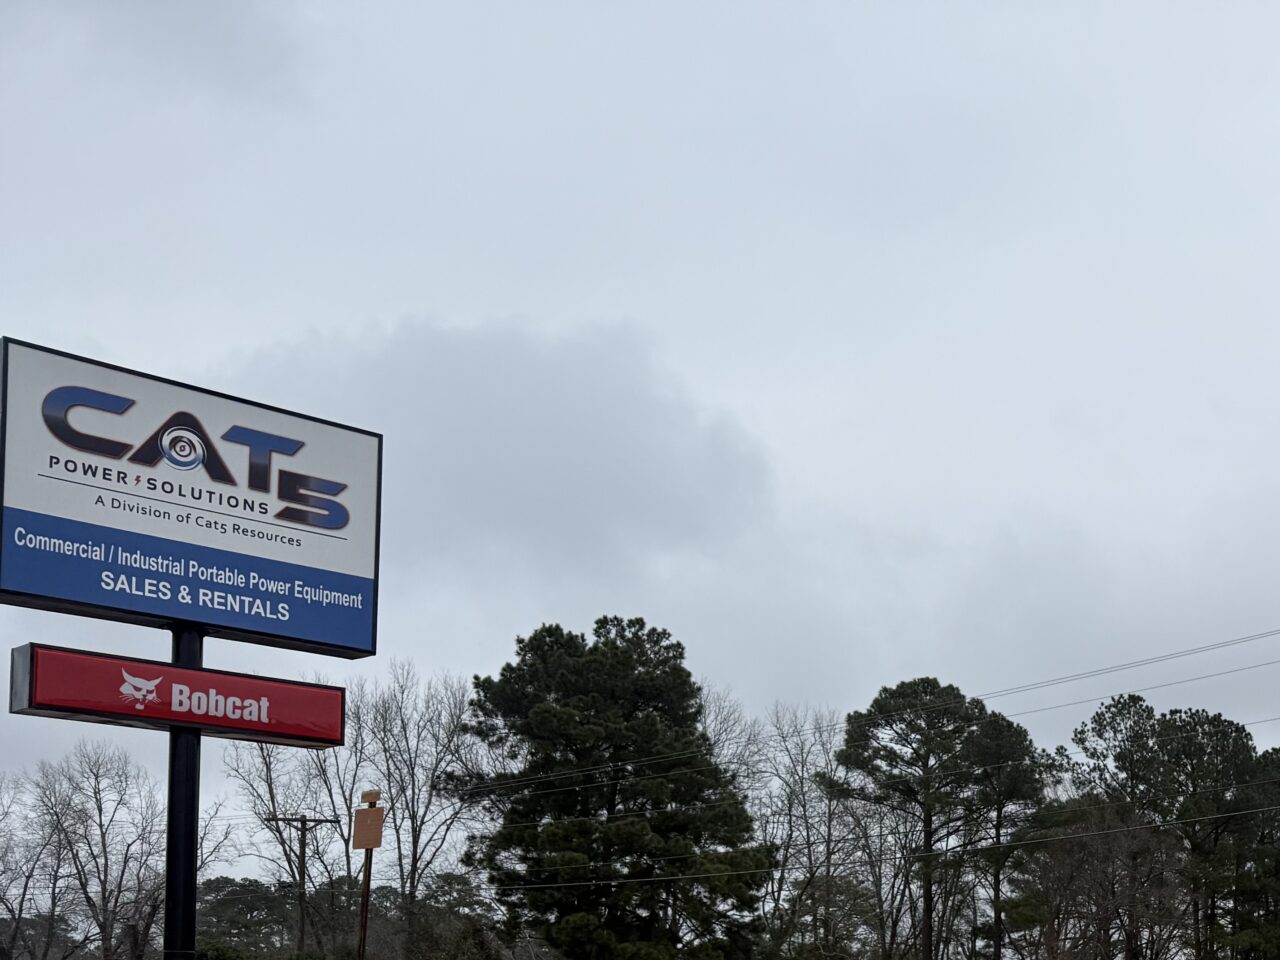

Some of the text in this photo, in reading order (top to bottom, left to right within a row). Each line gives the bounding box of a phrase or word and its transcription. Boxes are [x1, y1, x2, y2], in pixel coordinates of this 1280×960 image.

[49, 455, 270, 515] POWER SOLUTIONS
[95, 494, 302, 548] A Division of Cat5 Resources
[14, 526, 363, 609] Commercial / Industrial Portable Power Equipment
[100, 571, 290, 621] SALES & RENTALS
[171, 683, 270, 723] Bobcat
